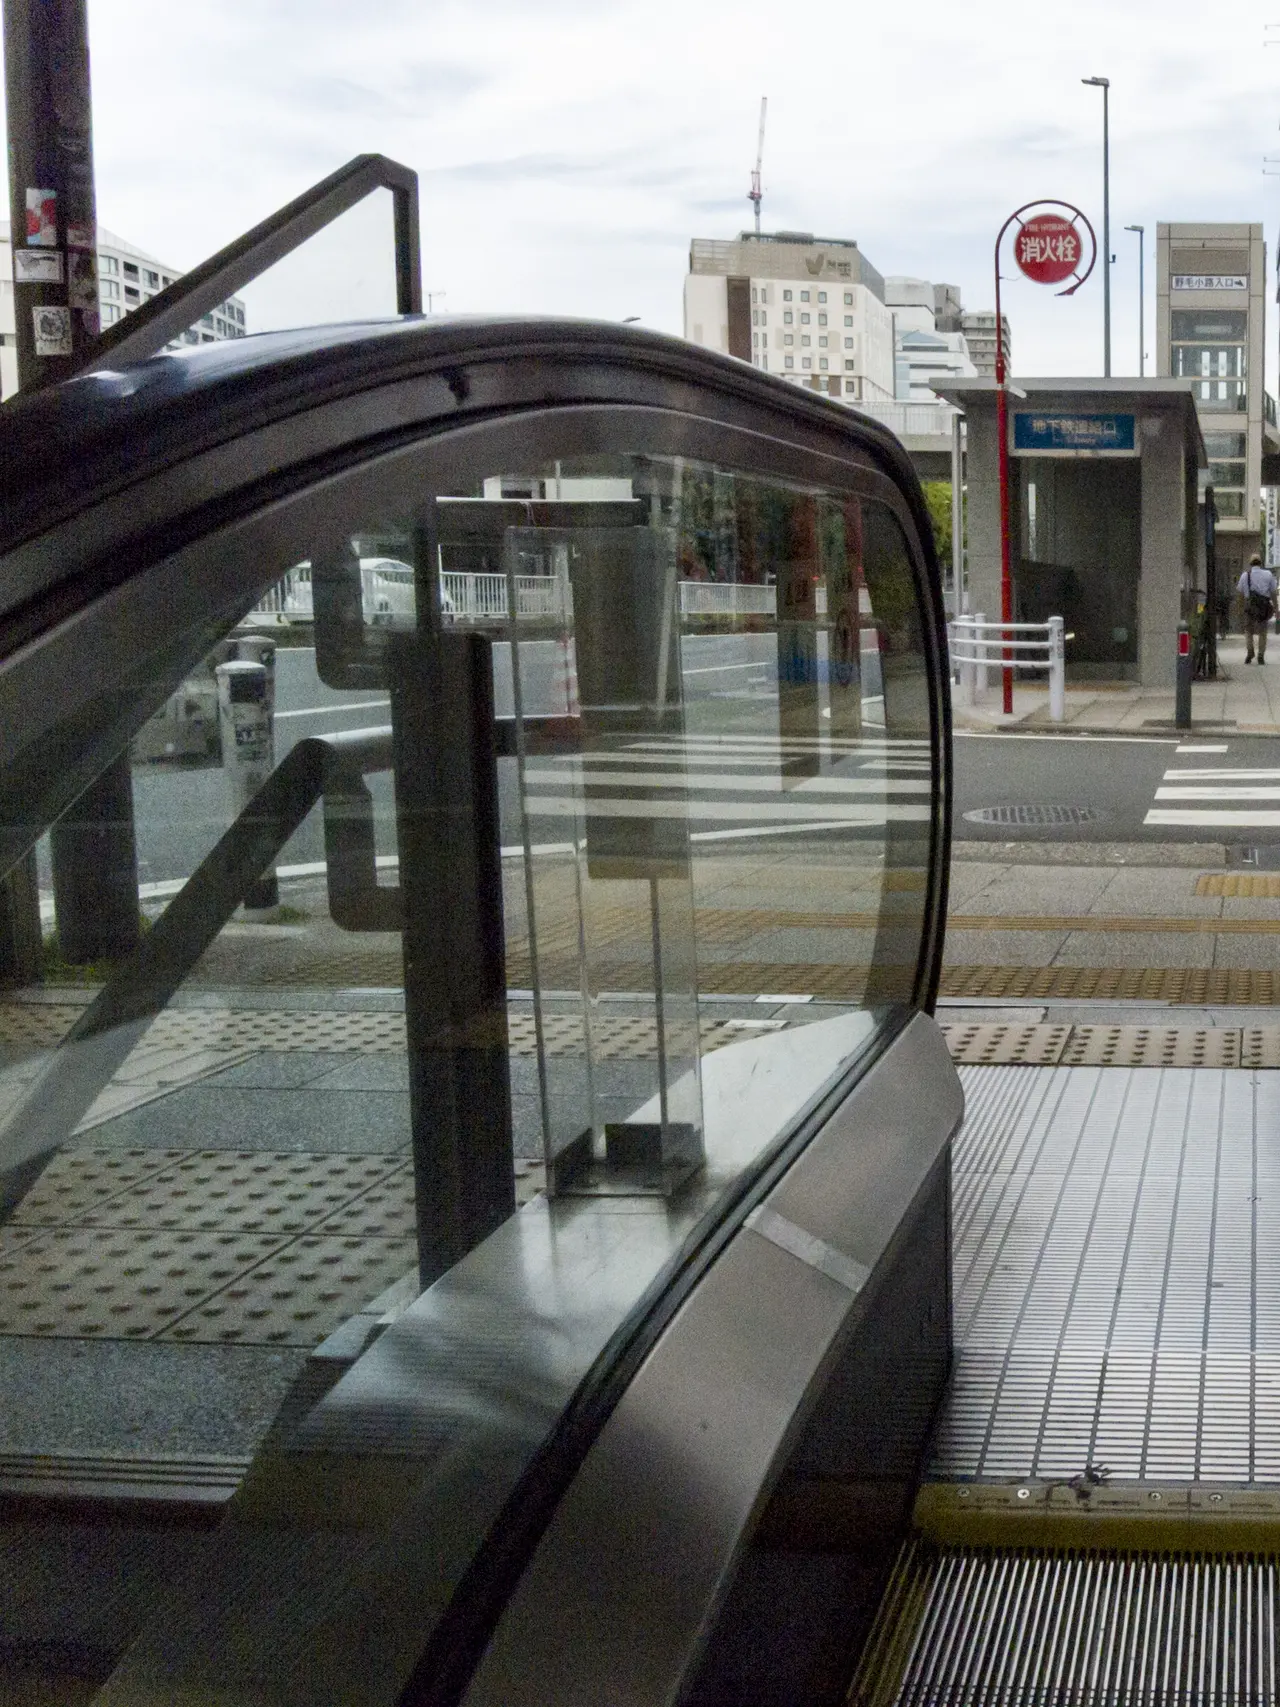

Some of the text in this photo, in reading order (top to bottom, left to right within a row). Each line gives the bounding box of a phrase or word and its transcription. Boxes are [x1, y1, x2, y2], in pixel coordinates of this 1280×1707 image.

[1020, 235, 1077, 263] 消火栓
[1174, 277, 1234, 288] 野毛小路入口
